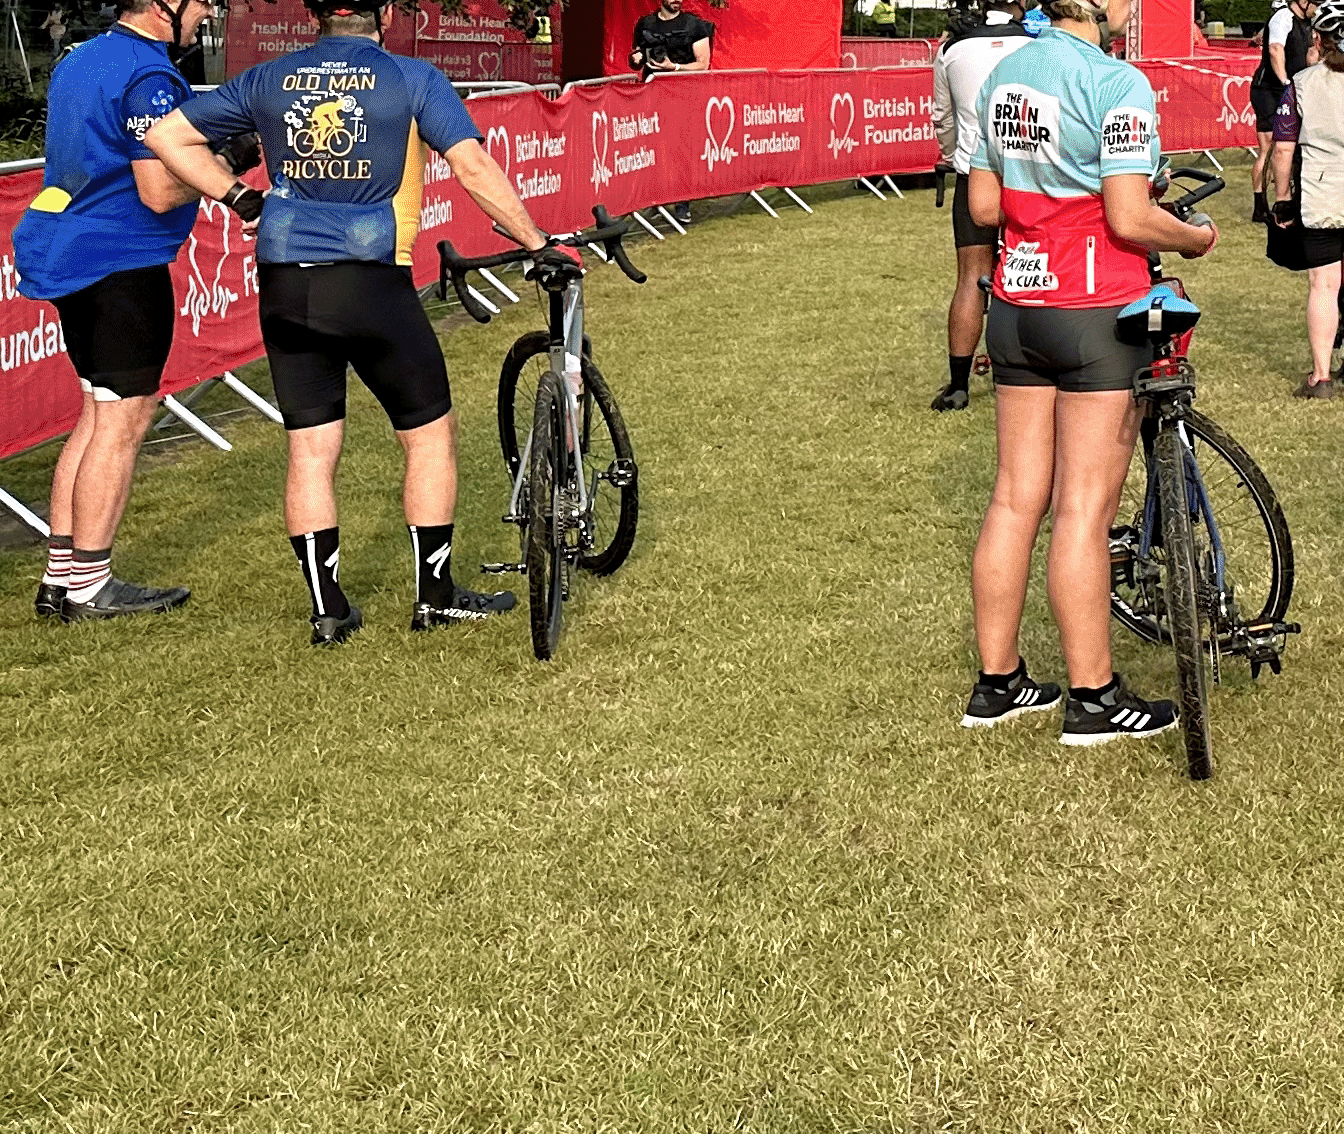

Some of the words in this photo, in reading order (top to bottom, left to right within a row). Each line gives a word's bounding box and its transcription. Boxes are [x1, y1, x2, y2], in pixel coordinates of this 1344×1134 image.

[439, 15, 477, 27] British
[479, 16, 509, 28] Hear
[438, 29, 505, 42] Foundation
[282, 74, 321, 91] OLD
[328, 74, 376, 91] MAN
[863, 96, 915, 119] British
[1006, 93, 1023, 104] THE
[743, 103, 776, 128] British
[777, 103, 804, 125] Heart
[995, 98, 1039, 124] BRAIN
[1113, 114, 1131, 123] THE
[864, 121, 936, 145] Foundati
[1103, 116, 1147, 136] BRAIN
[743, 131, 801, 157] Foundation
[282, 159, 372, 180] BICYCLE
[420, 199, 453, 231] ndation
[1016, 274, 1053, 287] CURE!
